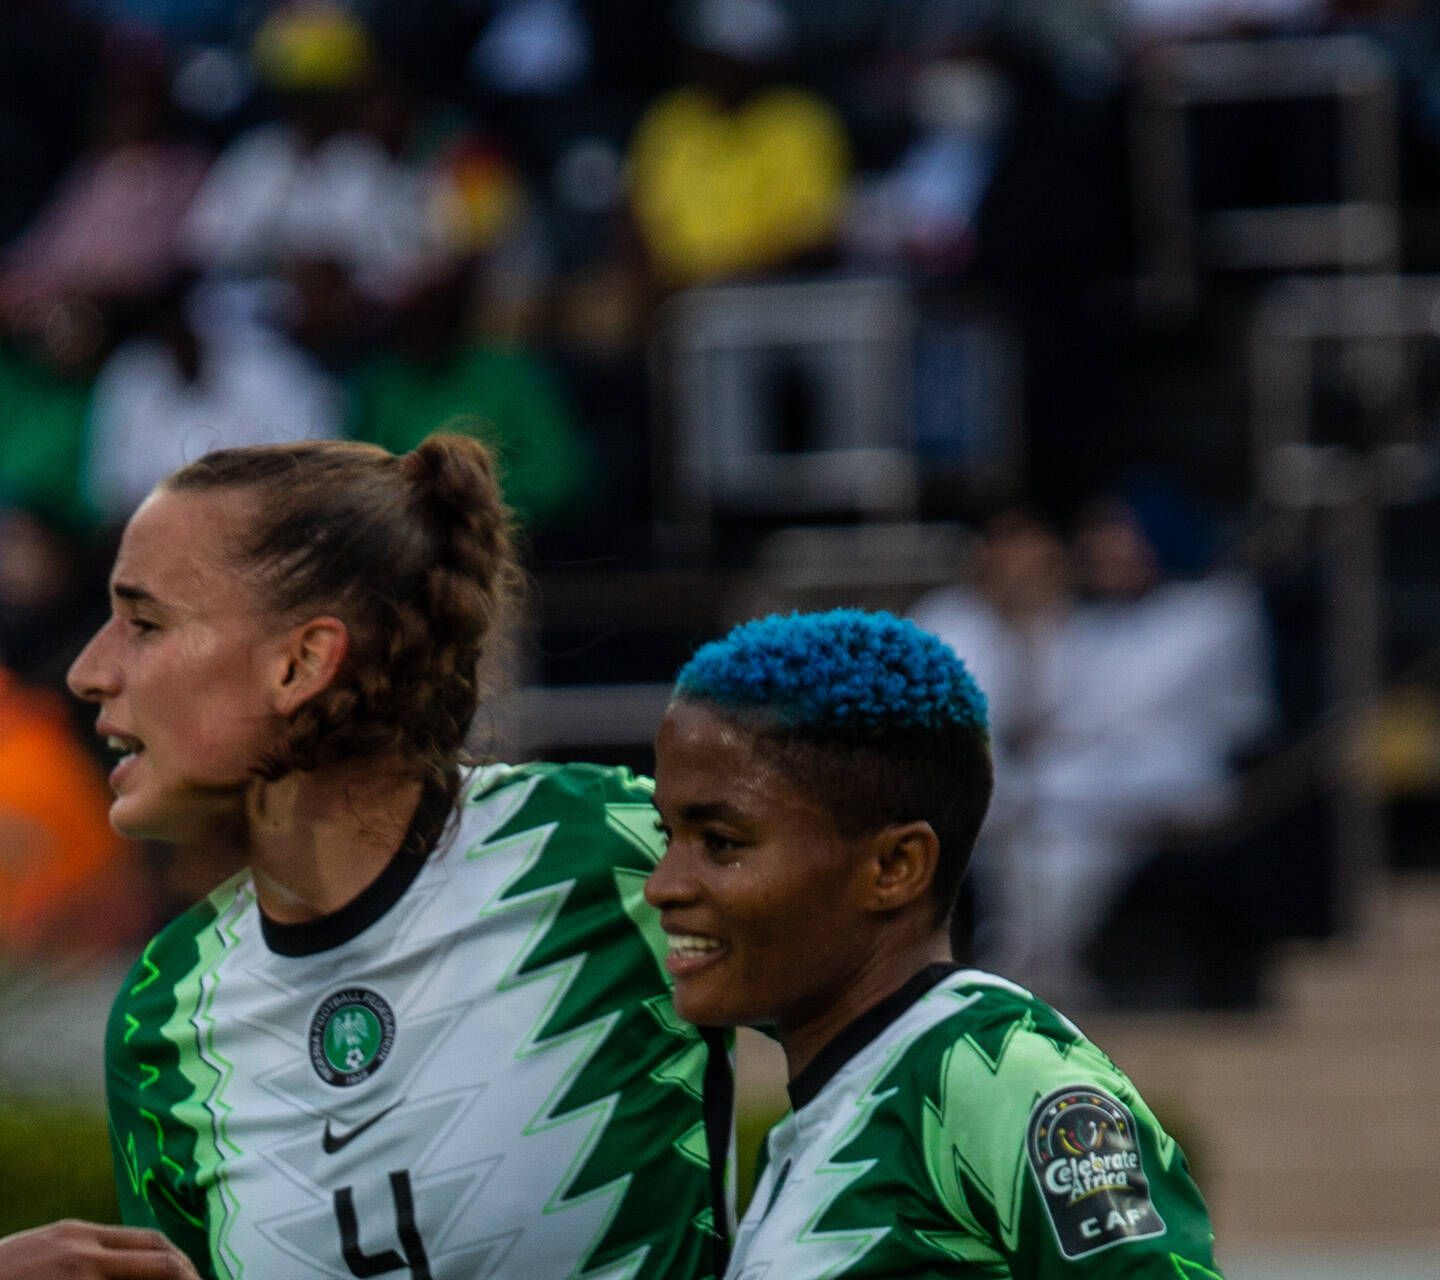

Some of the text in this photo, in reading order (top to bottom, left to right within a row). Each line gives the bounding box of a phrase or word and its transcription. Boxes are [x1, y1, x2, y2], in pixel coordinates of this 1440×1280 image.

[1045, 1150, 1138, 1194] Celebrate
[1071, 1170, 1128, 1201] Africa
[1080, 1208, 1141, 1239] CAF
